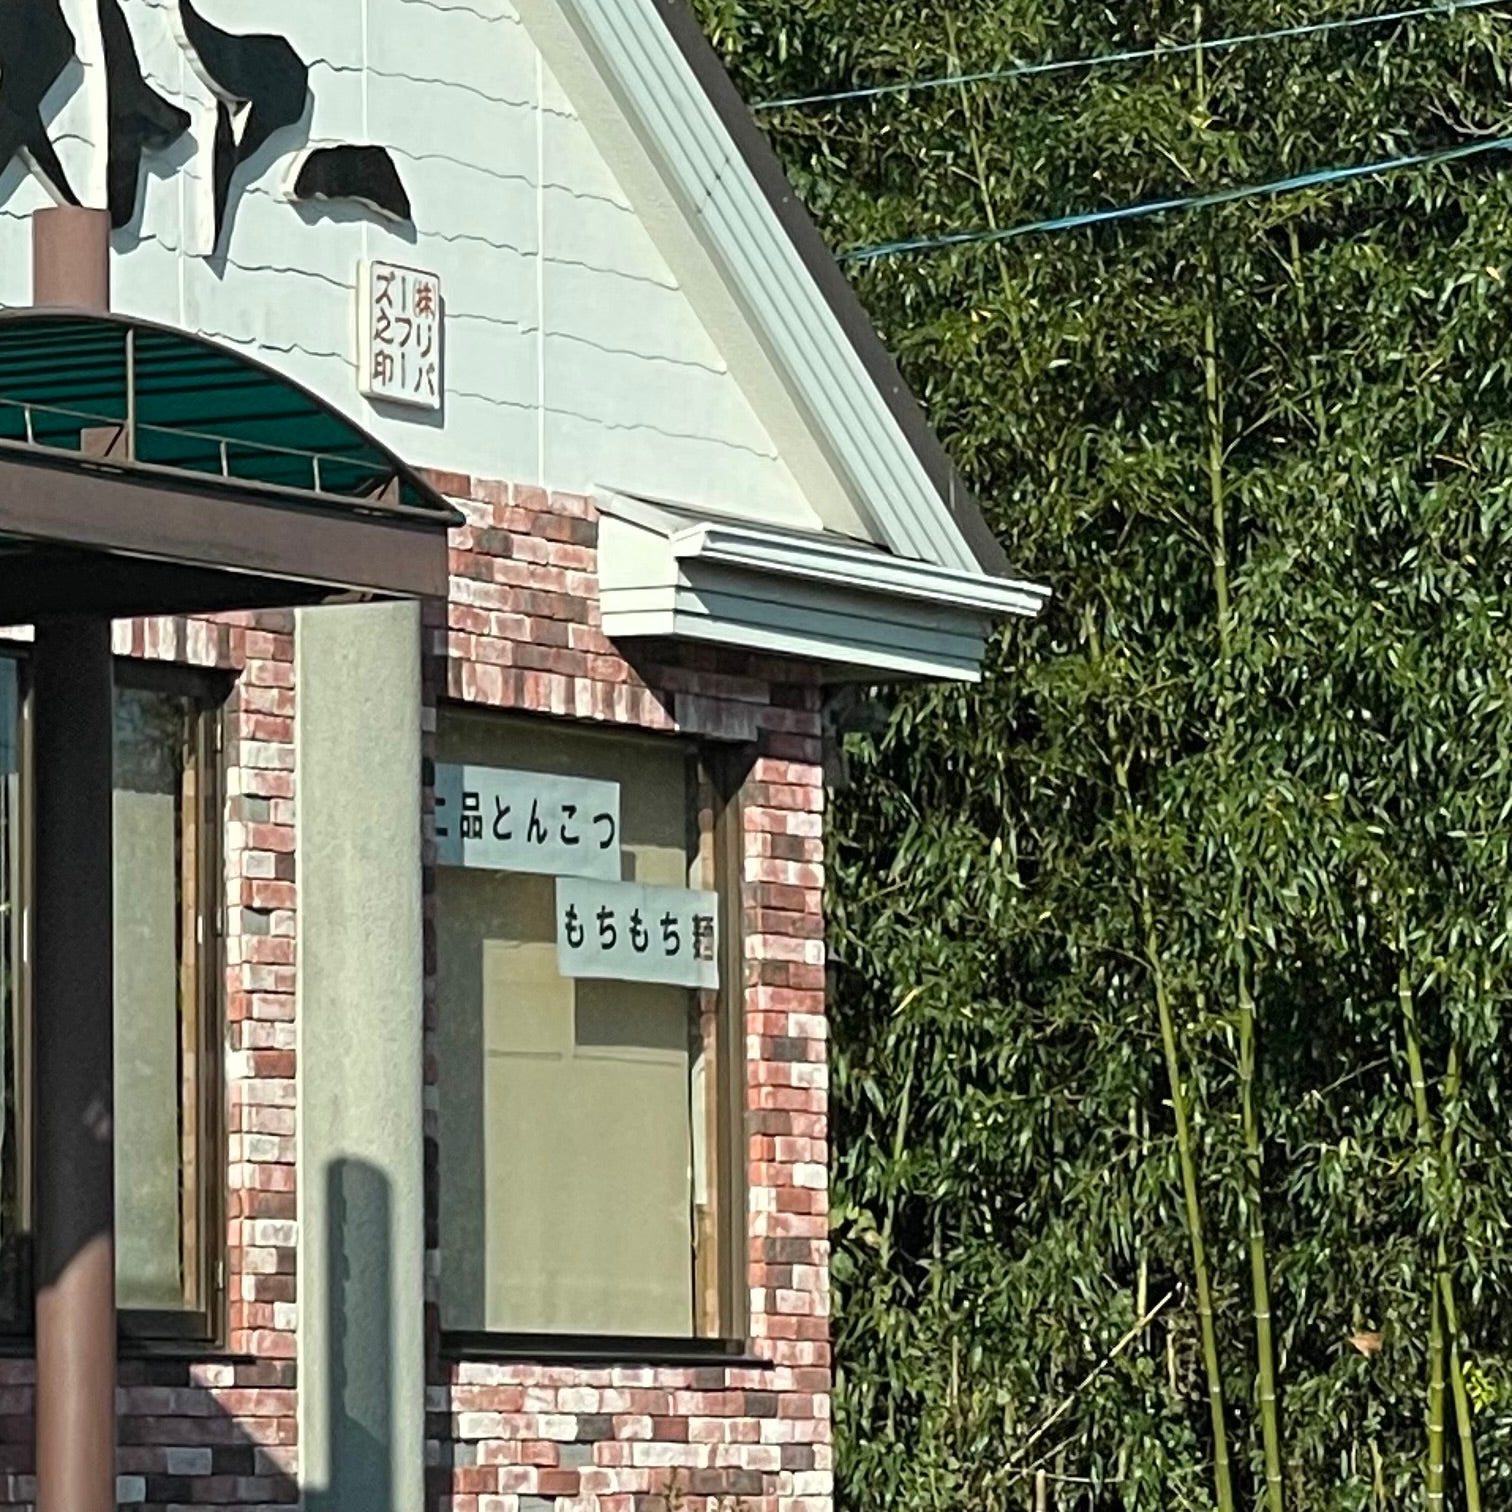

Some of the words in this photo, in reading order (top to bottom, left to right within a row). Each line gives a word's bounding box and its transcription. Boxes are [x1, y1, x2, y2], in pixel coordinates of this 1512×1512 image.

[564, 903, 714, 962] もちもち麺
